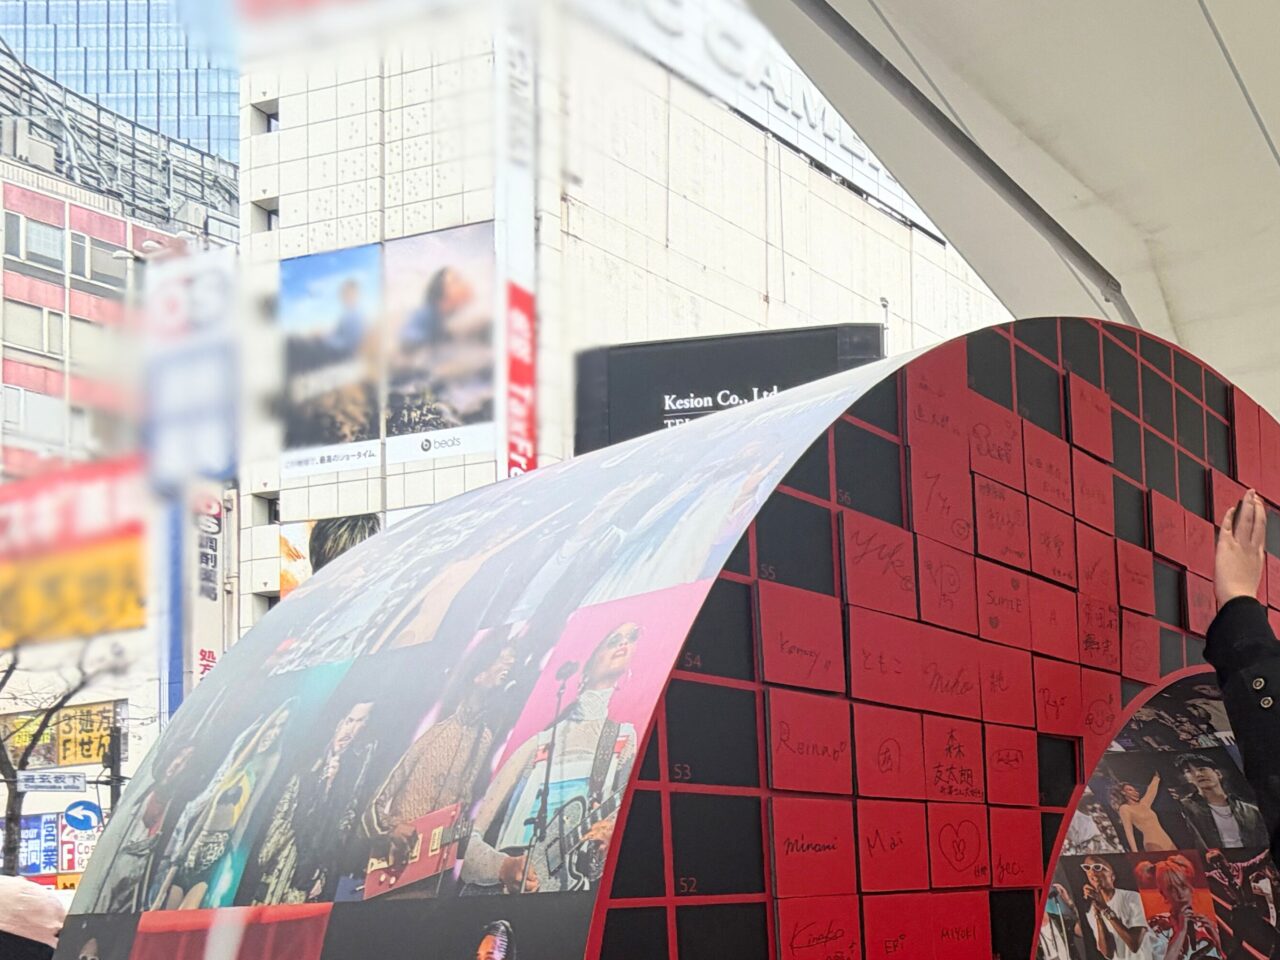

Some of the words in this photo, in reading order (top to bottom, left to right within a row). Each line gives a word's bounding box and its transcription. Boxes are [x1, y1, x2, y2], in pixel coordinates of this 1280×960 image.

[664, 393, 713, 411] Kesion
[716, 389, 749, 406] Co.,
[433, 436, 461, 450] beats
[837, 489, 852, 505] 56
[760, 563, 776, 580] 55
[684, 651, 702, 669] 54
[861, 648, 902, 675] ともこ
[673, 763, 691, 780] 53
[866, 828, 903, 858] Mai
[679, 876, 698, 894] 52
